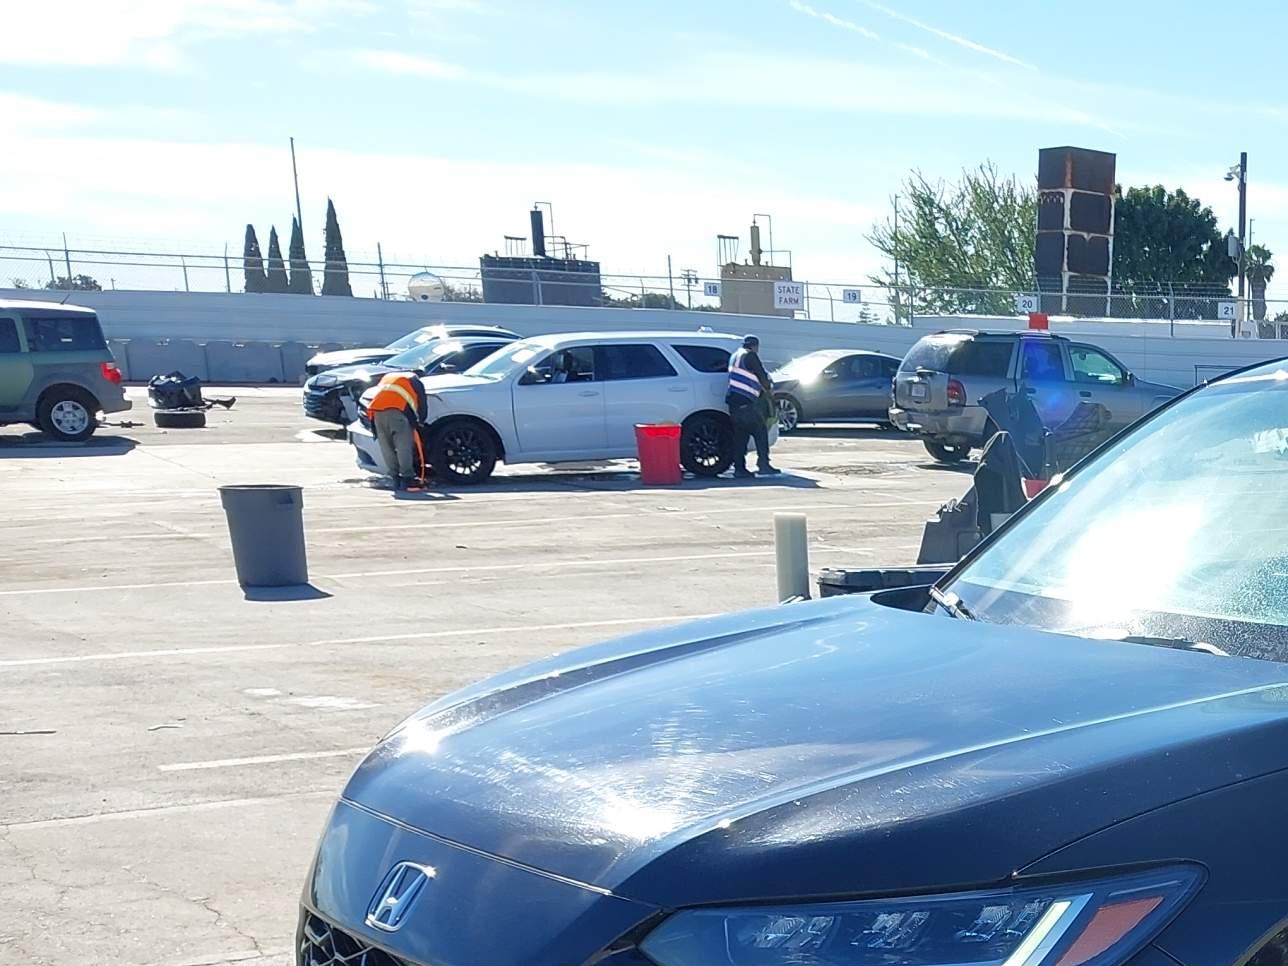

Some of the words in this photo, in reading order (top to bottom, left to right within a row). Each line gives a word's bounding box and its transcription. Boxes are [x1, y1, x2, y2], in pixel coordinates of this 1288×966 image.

[708, 285, 718, 294] 18
[777, 286, 800, 295] STATE
[778, 297, 799, 305] FARM
[847, 292, 857, 301] 19
[1022, 300, 1033, 309] 20
[1223, 306, 1234, 316] 21
